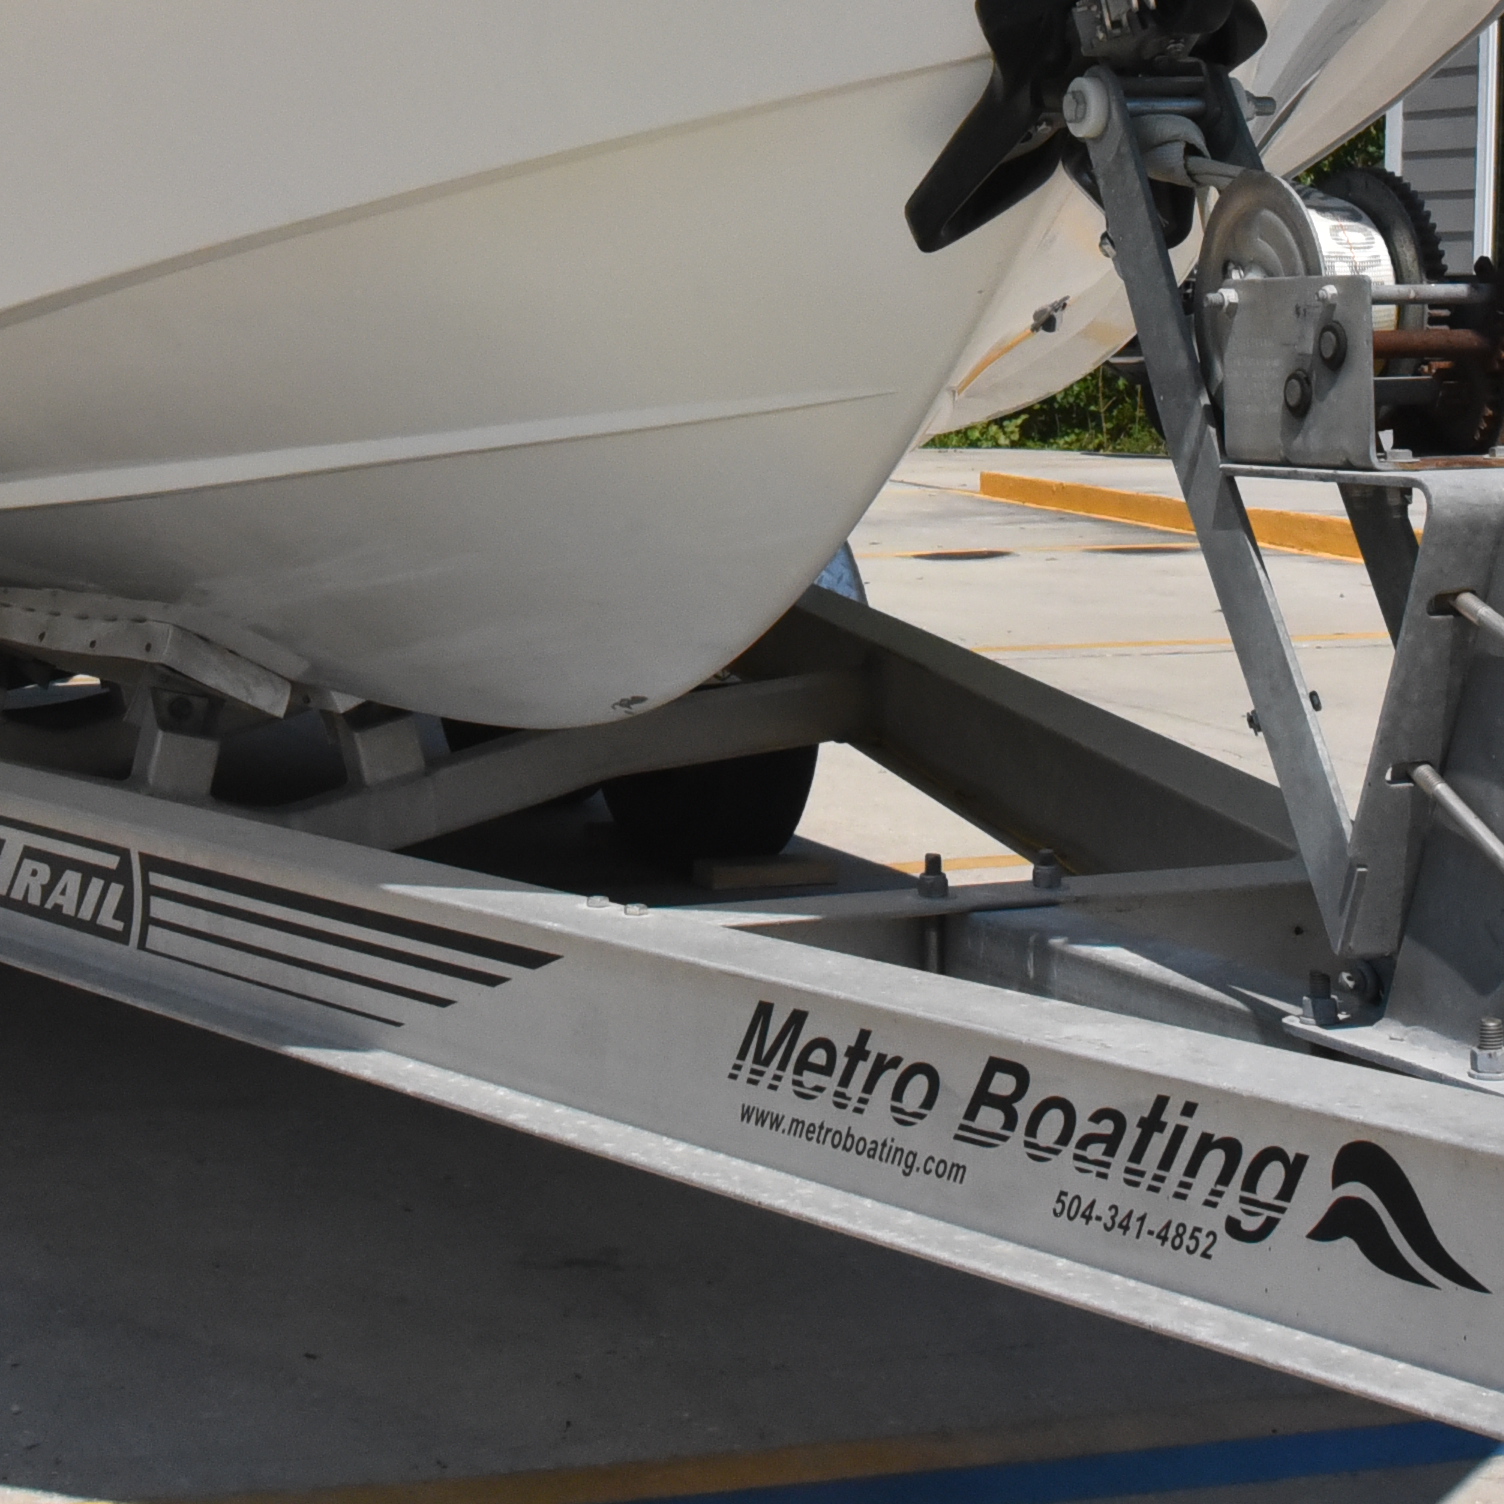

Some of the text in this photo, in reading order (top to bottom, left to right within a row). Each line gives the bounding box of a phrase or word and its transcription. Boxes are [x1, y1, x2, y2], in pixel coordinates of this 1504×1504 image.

[727, 999, 1310, 1244] Metro Boating
[739, 1102, 967, 1186] www.metroboating.com
[1052, 1189, 1218, 1260] 504-341-4852
